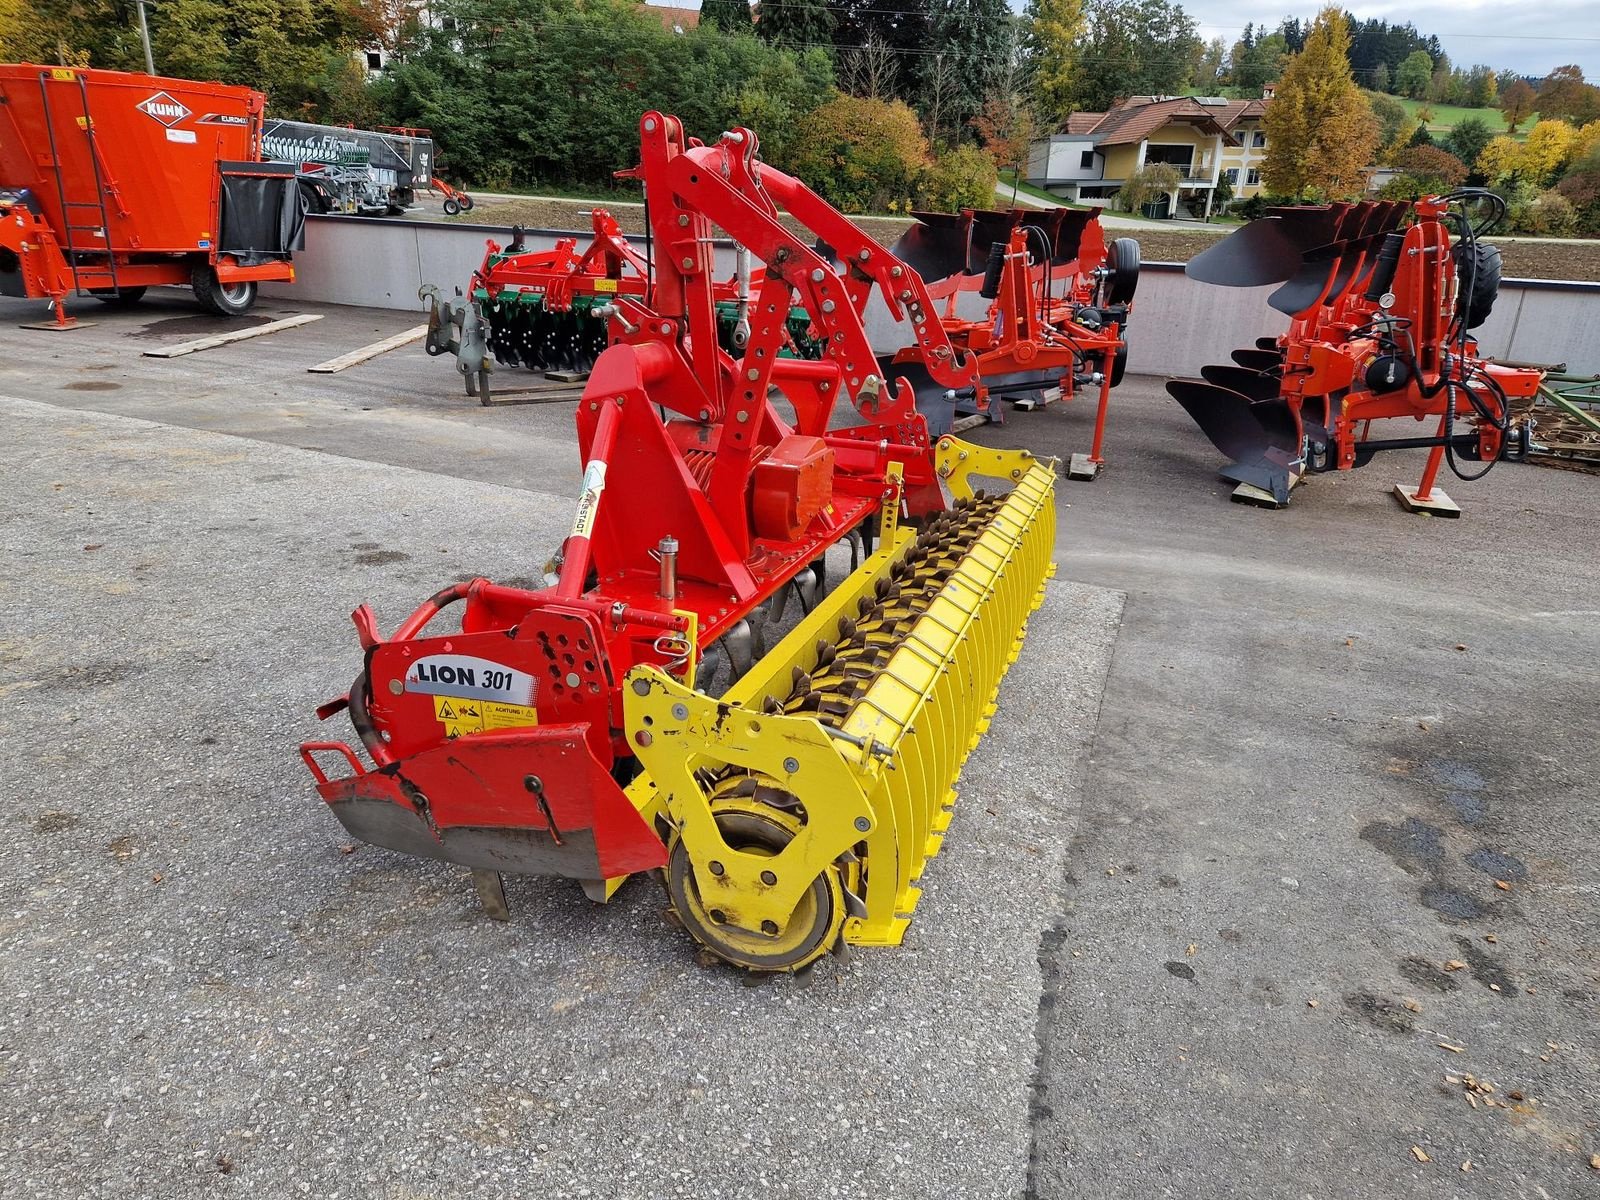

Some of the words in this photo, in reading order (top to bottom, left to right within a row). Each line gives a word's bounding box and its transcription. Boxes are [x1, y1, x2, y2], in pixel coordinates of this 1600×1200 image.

[147, 102, 184, 117] KUHN
[417, 663, 476, 687] LION
[481, 670, 513, 691] 301
[495, 706, 521, 715] ACHTUNG
